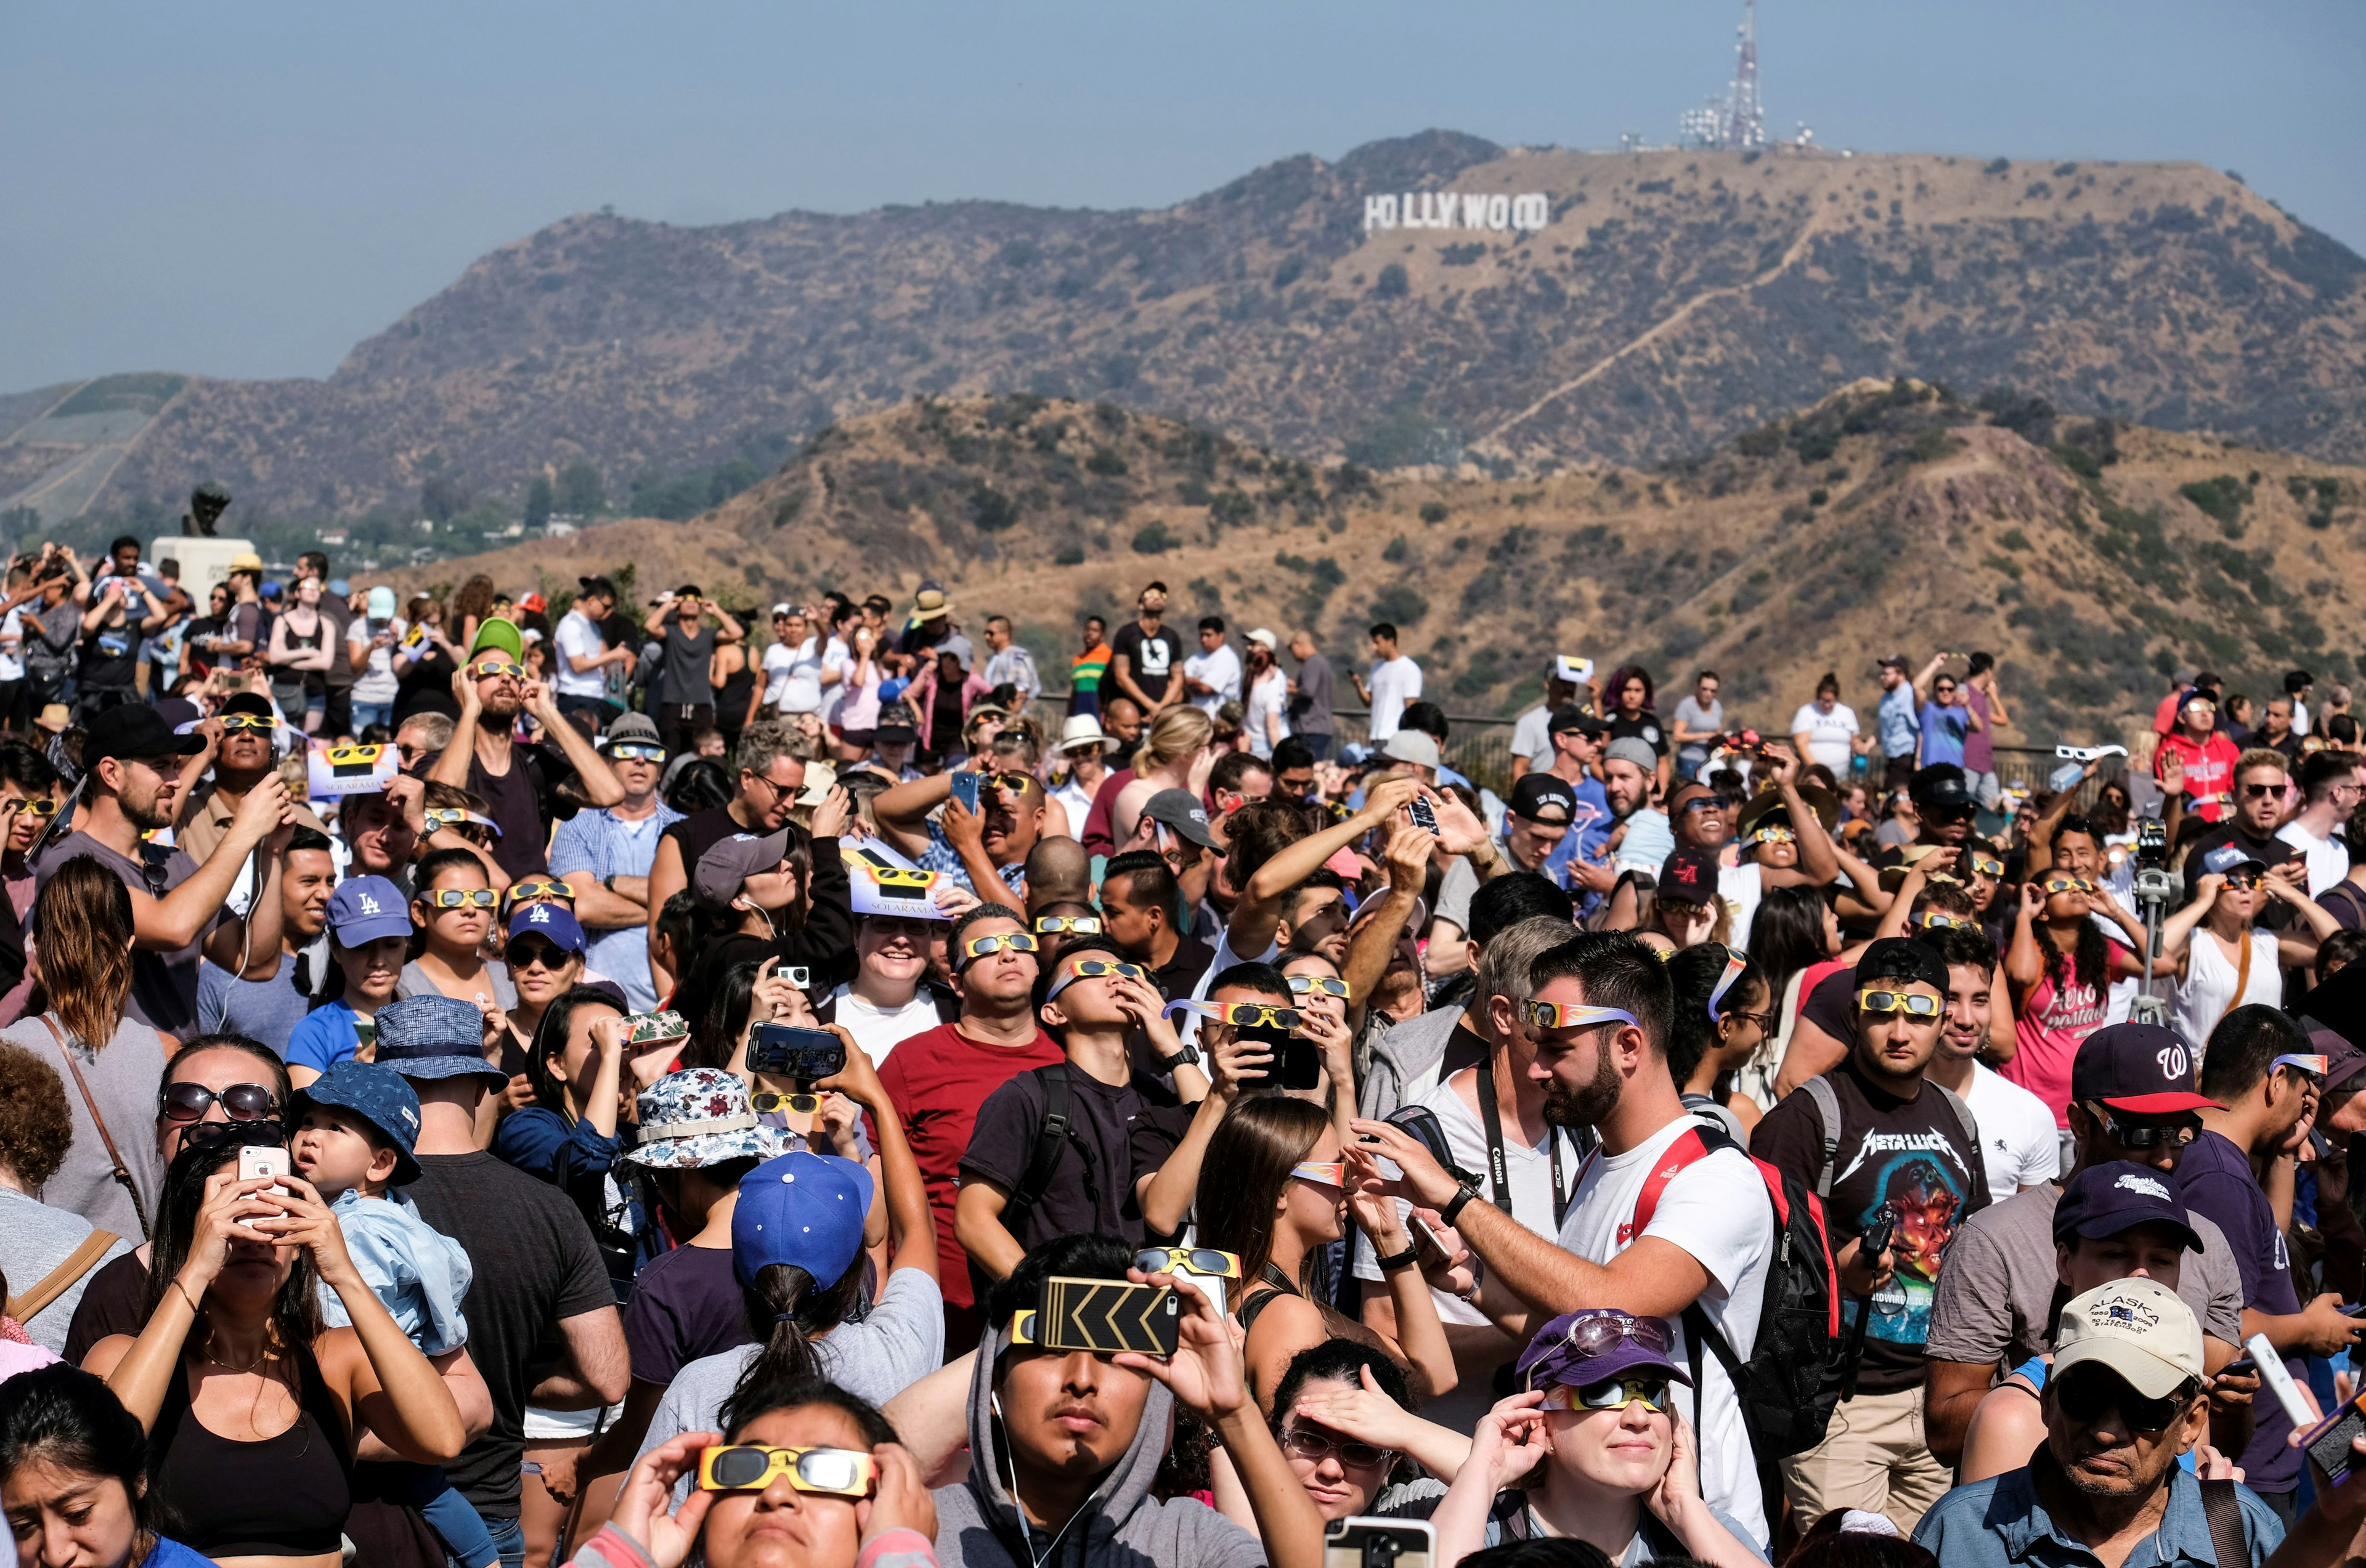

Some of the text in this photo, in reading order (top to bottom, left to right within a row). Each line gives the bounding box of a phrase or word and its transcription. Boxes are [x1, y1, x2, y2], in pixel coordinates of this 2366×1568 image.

[1364, 192, 1549, 231] HOLLYWOOD
[325, 781, 383, 790] SOLARAMA
[1536, 792, 1570, 808] LOS ANGELES
[1672, 857, 1698, 885] LA
[358, 893, 381, 914] LA
[529, 904, 550, 924] LA
[871, 902, 935, 914] SOLARAMA
[2157, 1043, 2187, 1081] W
[1492, 1147, 1503, 1184] Canon
[1833, 1126, 1971, 1186] METALLICA
[1554, 1164, 1562, 1188] EOS
[2114, 1174, 2169, 1195] American
[2130, 1185, 2173, 1203] Woman
[2089, 1296, 2160, 1325] ALASKA
[2094, 1322, 2142, 1334] STATEHOOD
[2106, 1319, 2132, 1327] YEARS
[2132, 1316, 2153, 1327] 2009
